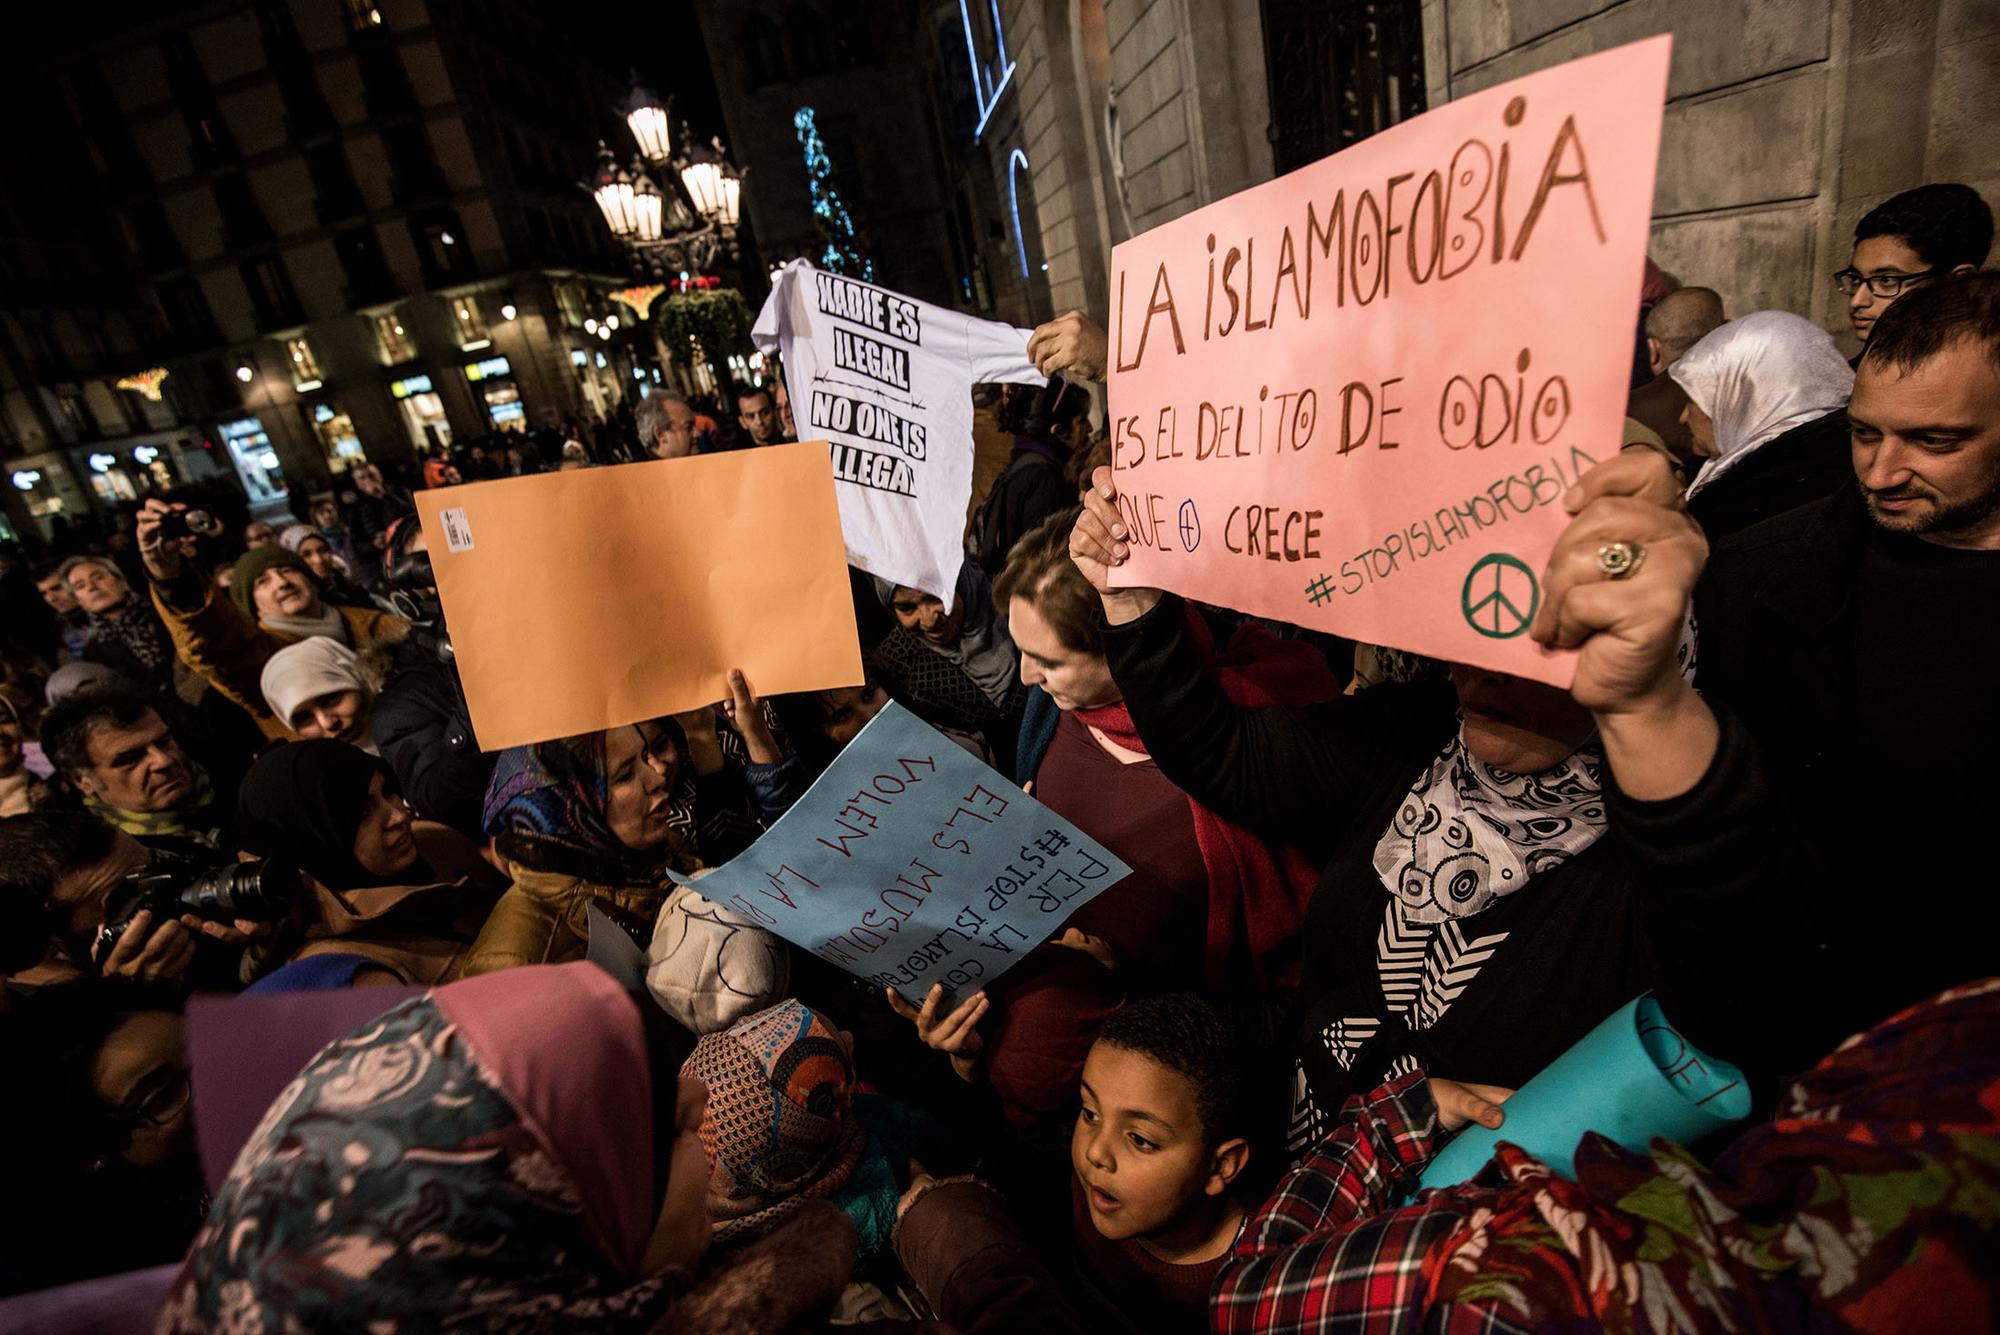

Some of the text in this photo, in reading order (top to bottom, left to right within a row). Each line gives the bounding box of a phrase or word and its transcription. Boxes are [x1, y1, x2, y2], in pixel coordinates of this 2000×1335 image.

[816, 273, 919, 343] NADIE ES
[1115, 261, 1186, 373] LA
[834, 329, 910, 390] ILEGAL
[812, 391, 926, 461] NO ONE IS
[1113, 347, 1572, 471] ES EL DELITO DE ODIO
[829, 442, 917, 497] LLEGA
[1118, 492, 1172, 552] QUE
[1224, 504, 1323, 562] CRECE
[816, 755, 936, 858] VOLEM
[931, 783, 1009, 856] ELS
[759, 863, 820, 910] LA
[1028, 848, 1110, 914] PER
[980, 924, 1029, 956] LA
